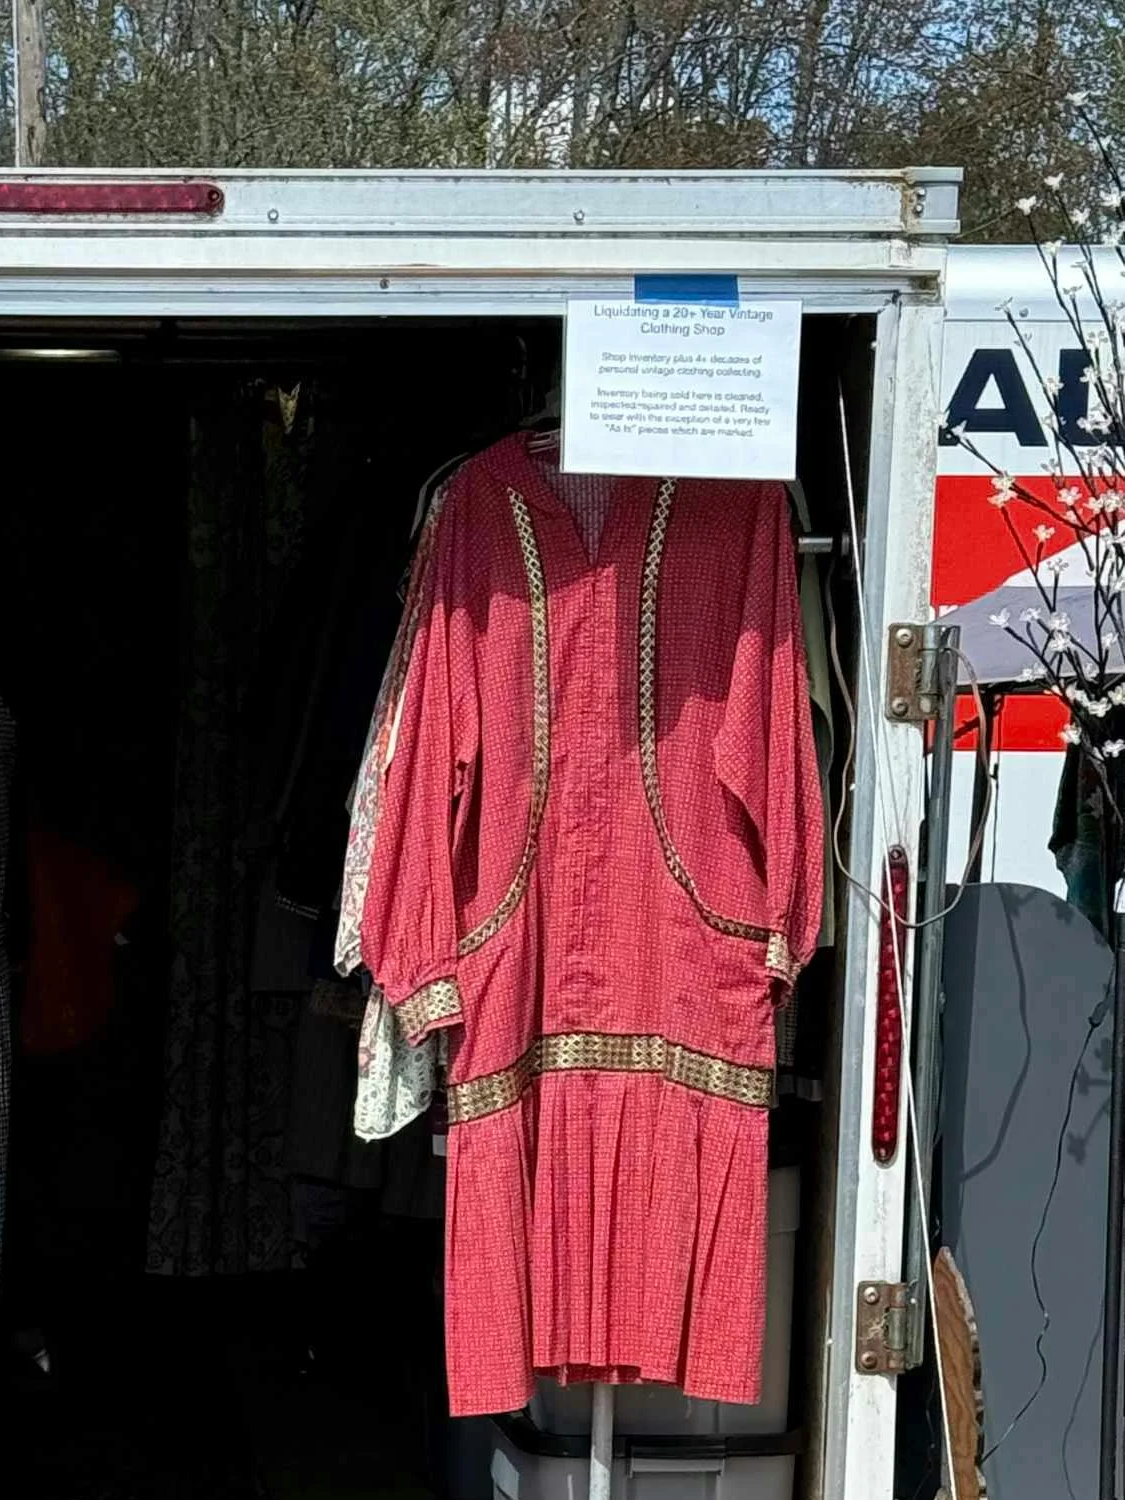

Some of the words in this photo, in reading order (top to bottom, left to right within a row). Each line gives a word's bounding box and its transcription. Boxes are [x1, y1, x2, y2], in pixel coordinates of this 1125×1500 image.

[594, 305, 659, 319] Liquidating
[663, 309, 669, 318] a
[673, 307, 696, 318] 20+
[700, 308, 725, 319] Year
[729, 308, 773, 322] Vintage
[641, 322, 690, 336] Clothing
[693, 324, 725, 336] Shop
[602, 352, 626, 362] Shop
[673, 354, 692, 364] plus
[710, 354, 750, 364] decades
[752, 355, 762, 364] of
[598, 365, 638, 375] personal
[642, 366, 674, 376] vintage
[677, 367, 713, 377] clothing
[597, 388, 639, 400] Inventory
[642, 389, 667, 400] being
[670, 390, 689, 400] sold
[692, 391, 712, 400] here
[714, 392, 722, 400] is
[679, 403, 696, 412] and
[740, 405, 771, 415] Ready
[590, 412, 599, 420] to
[627, 413, 646, 422] with
[648, 414, 662, 422] the
[712, 415, 723, 424] of
[732, 418, 752, 426] very
